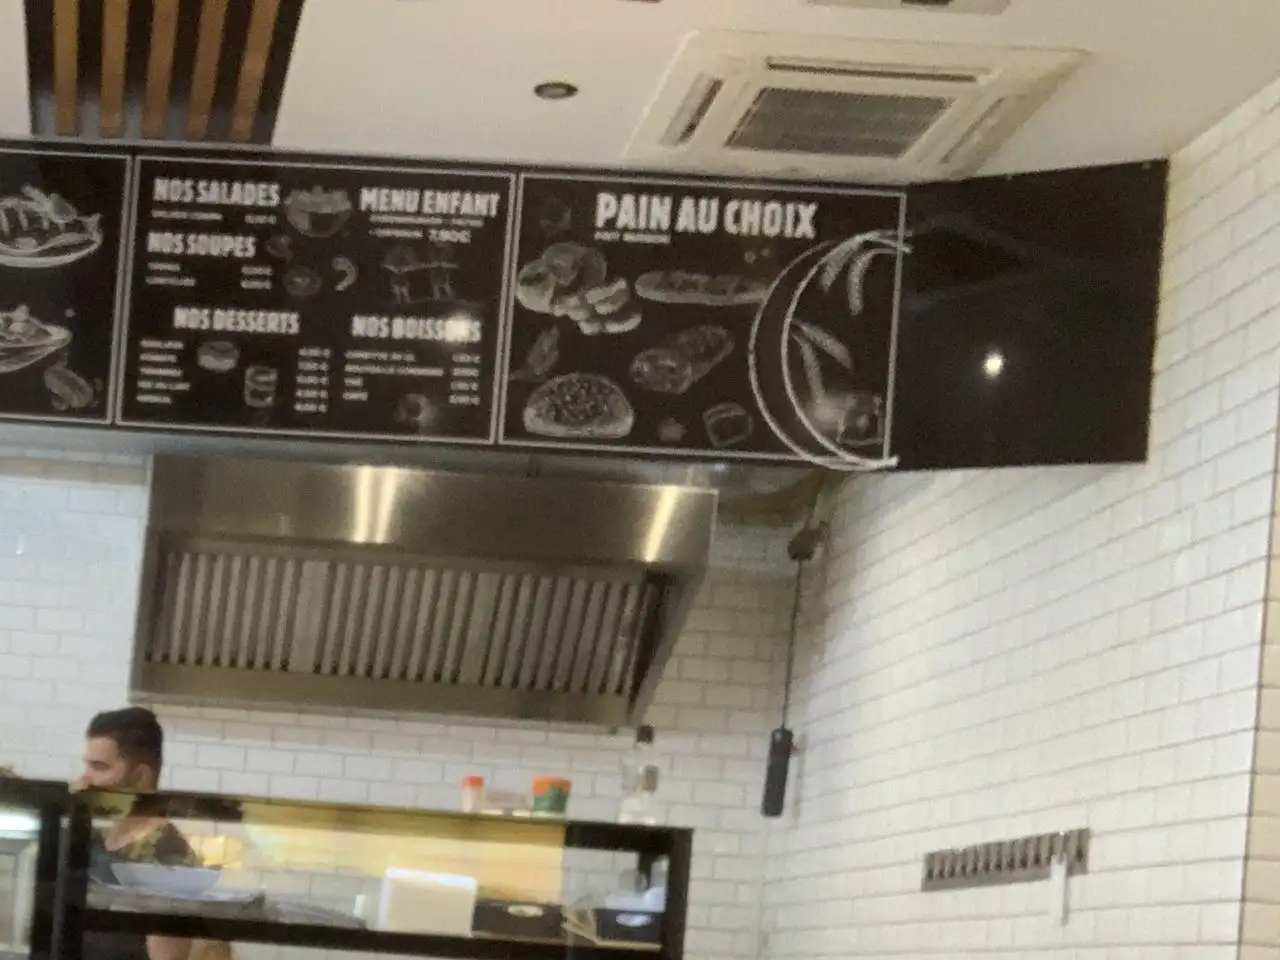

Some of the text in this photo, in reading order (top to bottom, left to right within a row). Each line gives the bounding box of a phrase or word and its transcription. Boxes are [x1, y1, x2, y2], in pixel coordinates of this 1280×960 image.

[153, 178, 280, 207] NOS SALADES
[359, 187, 501, 218] MENU ENFANT
[594, 192, 819, 240] PAIN AU CHOIX
[147, 232, 256, 258] NOS SOUPES
[174, 307, 300, 335] NOS DESSERTS
[352, 315, 481, 343] NOS BOISSS
